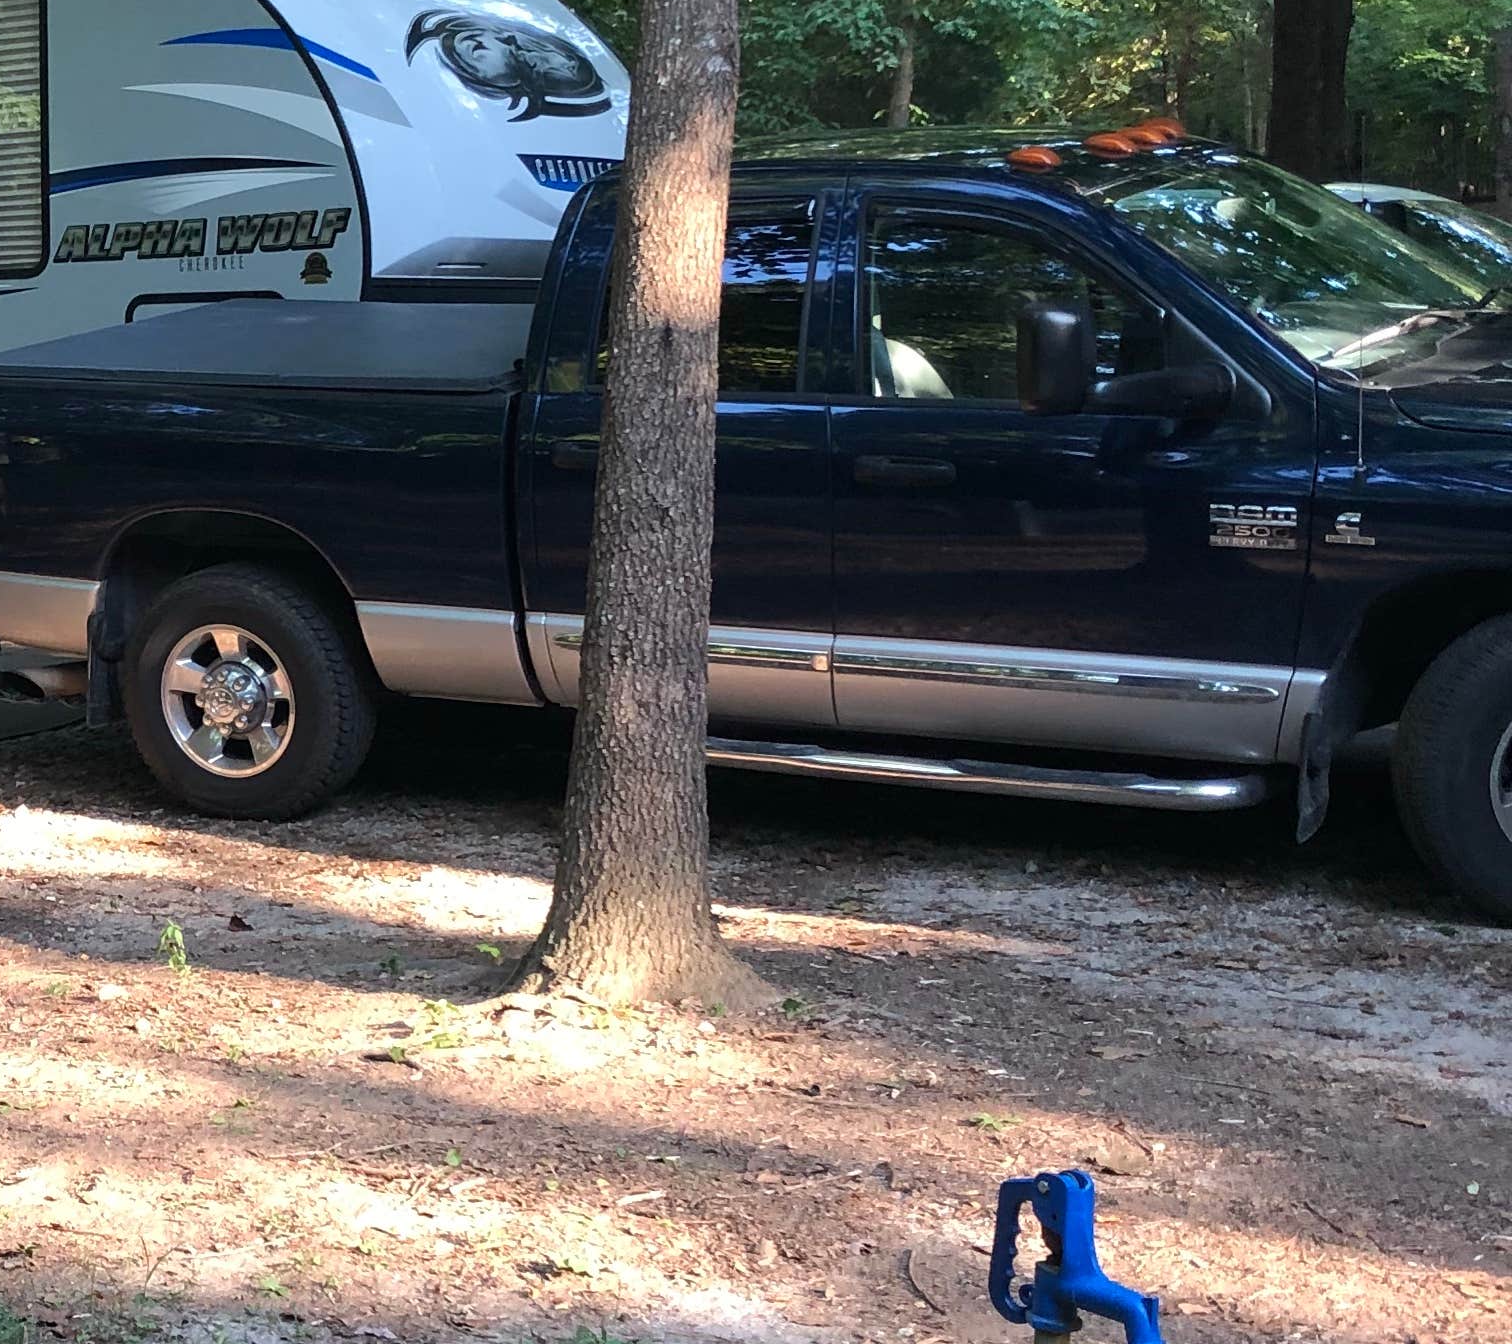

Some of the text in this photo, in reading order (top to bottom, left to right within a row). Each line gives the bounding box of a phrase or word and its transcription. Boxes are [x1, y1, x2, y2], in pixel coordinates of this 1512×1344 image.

[53, 208, 351, 263] ALPHA WOLF
[178, 255, 245, 273] CHEROKEE
[1216, 525, 1291, 538] 2500
